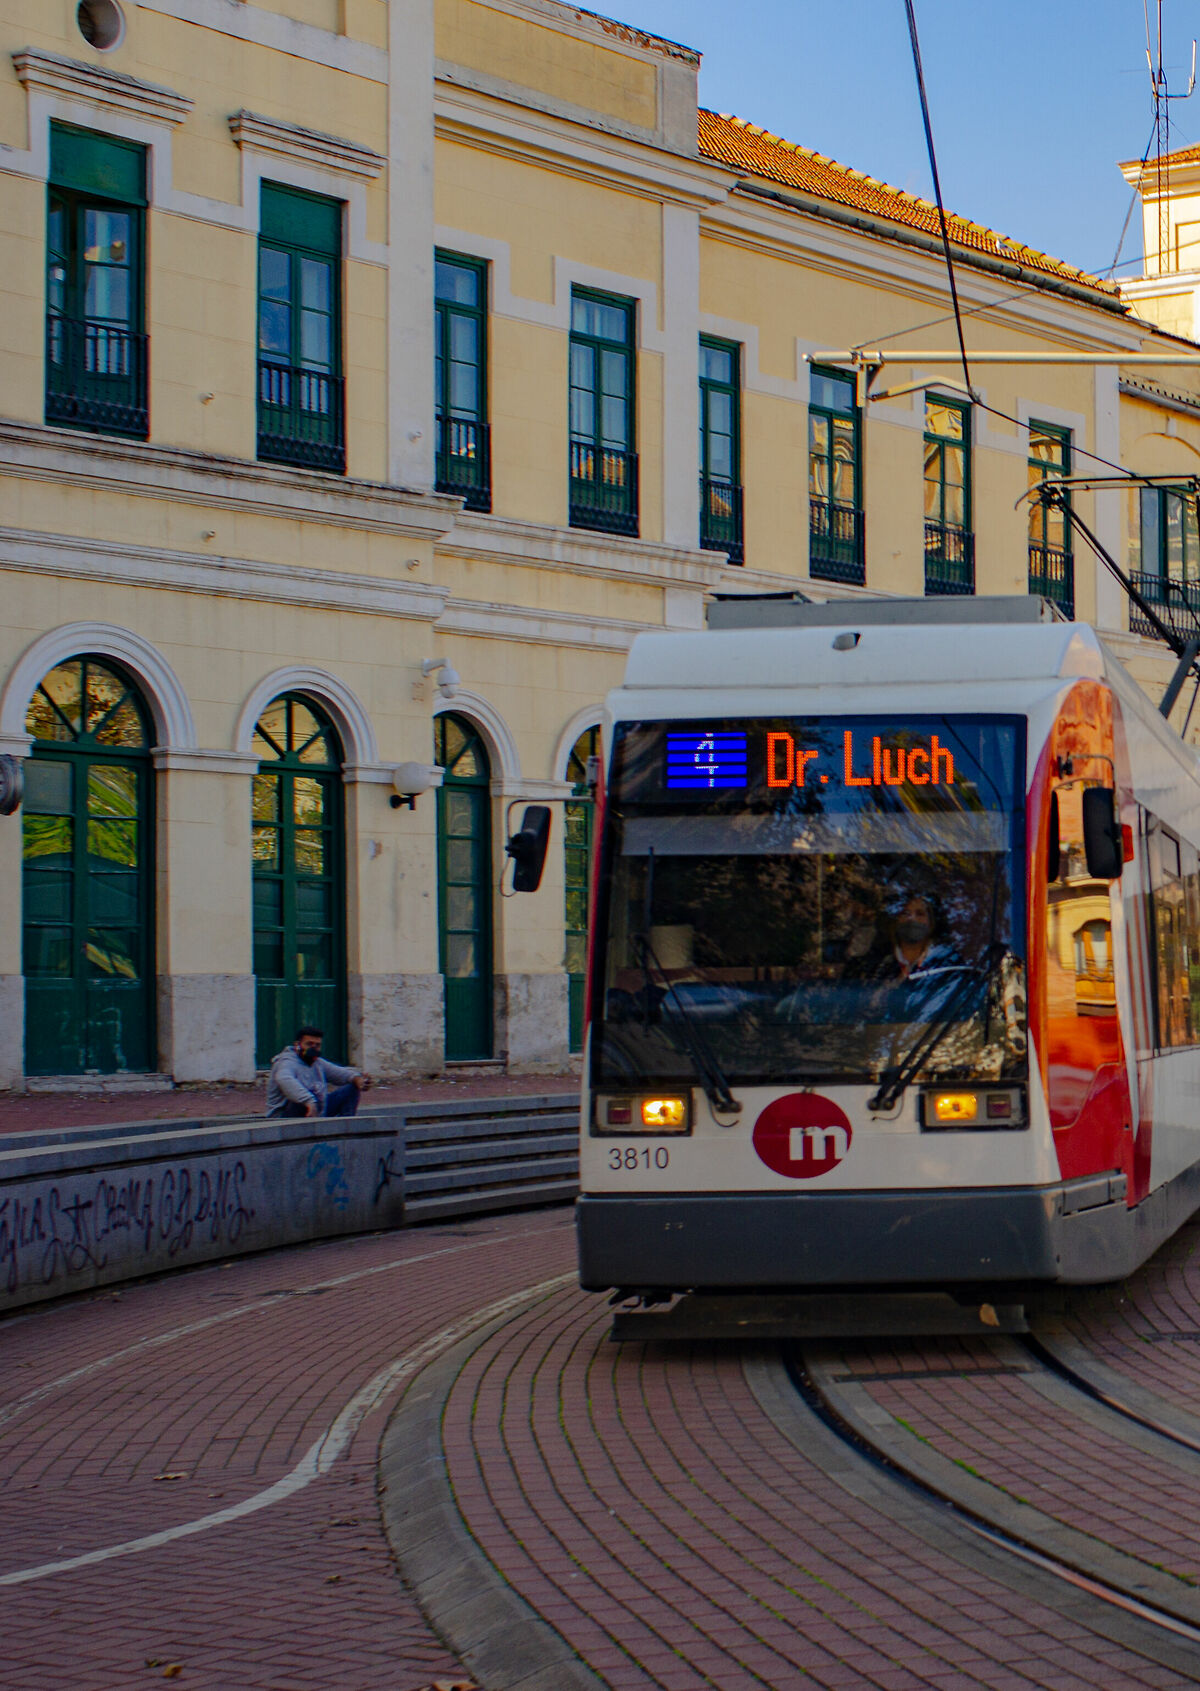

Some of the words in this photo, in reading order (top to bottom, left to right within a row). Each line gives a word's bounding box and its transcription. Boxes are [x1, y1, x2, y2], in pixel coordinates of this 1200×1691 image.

[767, 732, 829, 787] Dr.
[844, 730, 954, 786] Lluch
[609, 1147, 669, 1170] 3810
[789, 1125, 850, 1161] m
